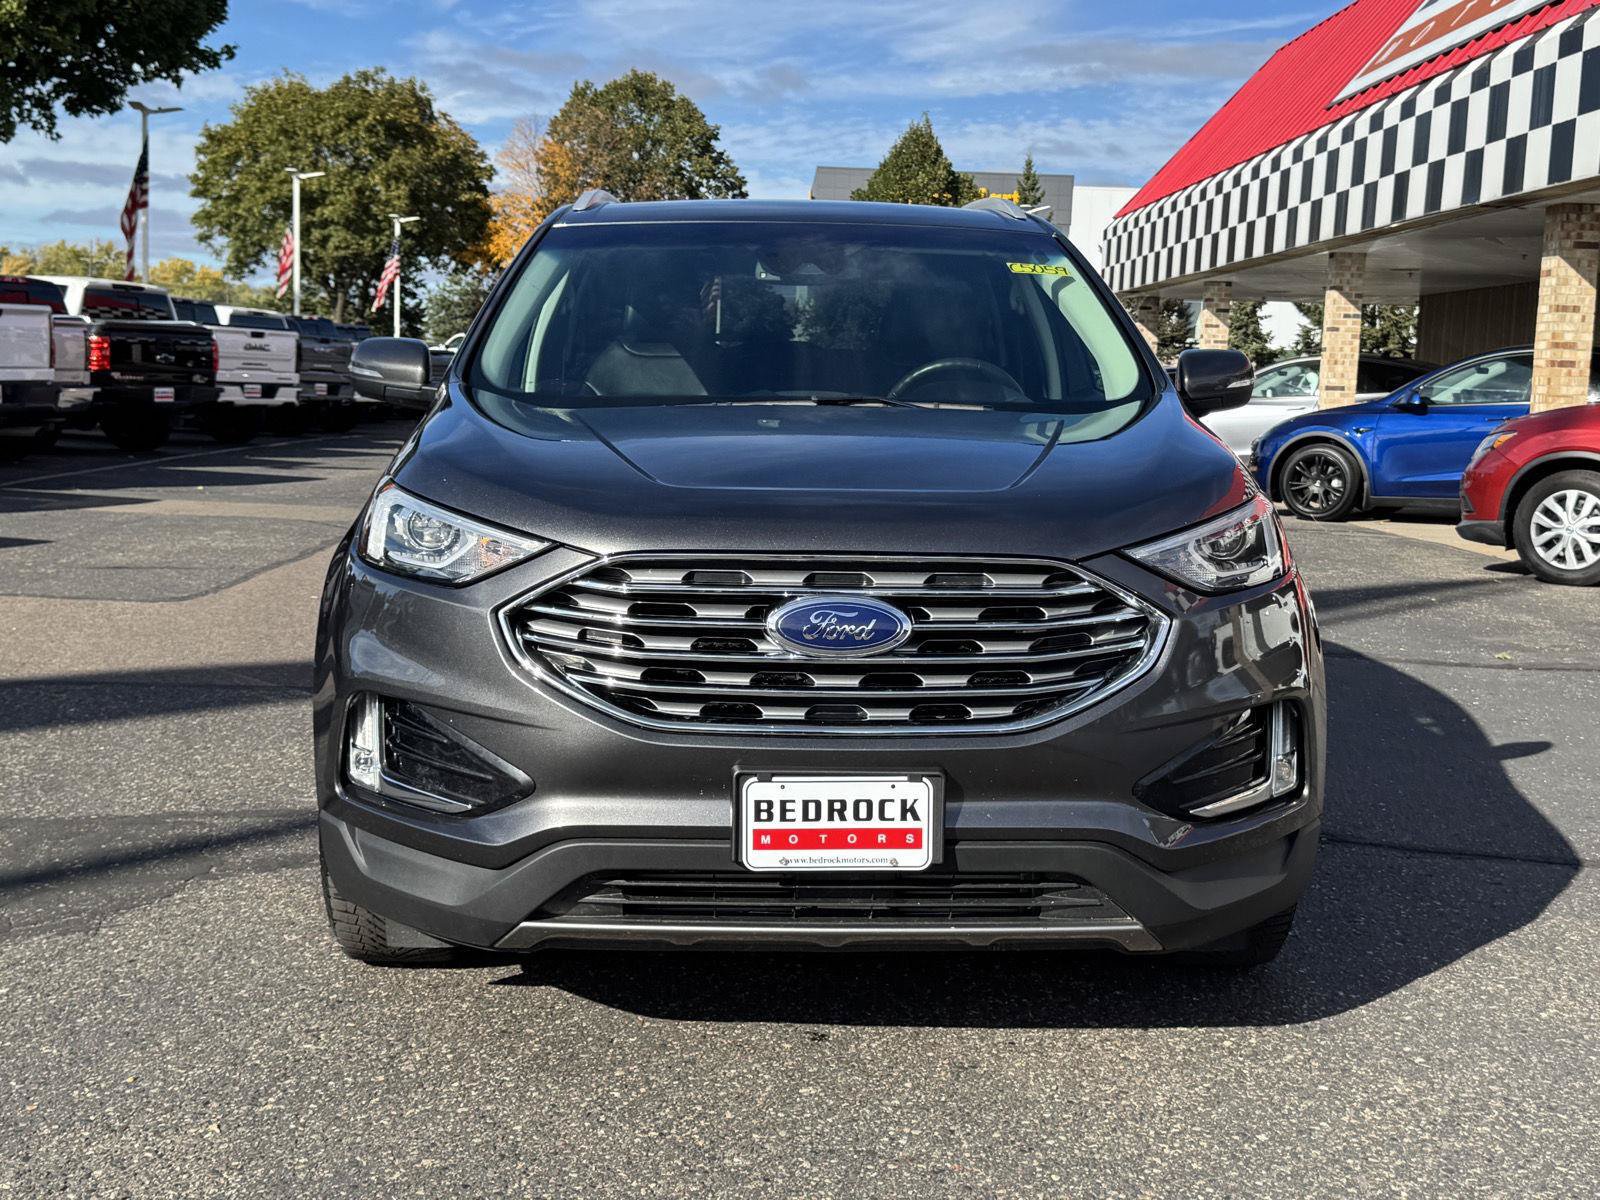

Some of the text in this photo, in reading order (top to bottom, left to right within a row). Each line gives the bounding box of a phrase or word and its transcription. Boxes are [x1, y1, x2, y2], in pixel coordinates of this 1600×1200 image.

[802, 610, 877, 640] Ford
[753, 799, 921, 822] BEDROCK
[760, 834, 914, 844] MOTORS
